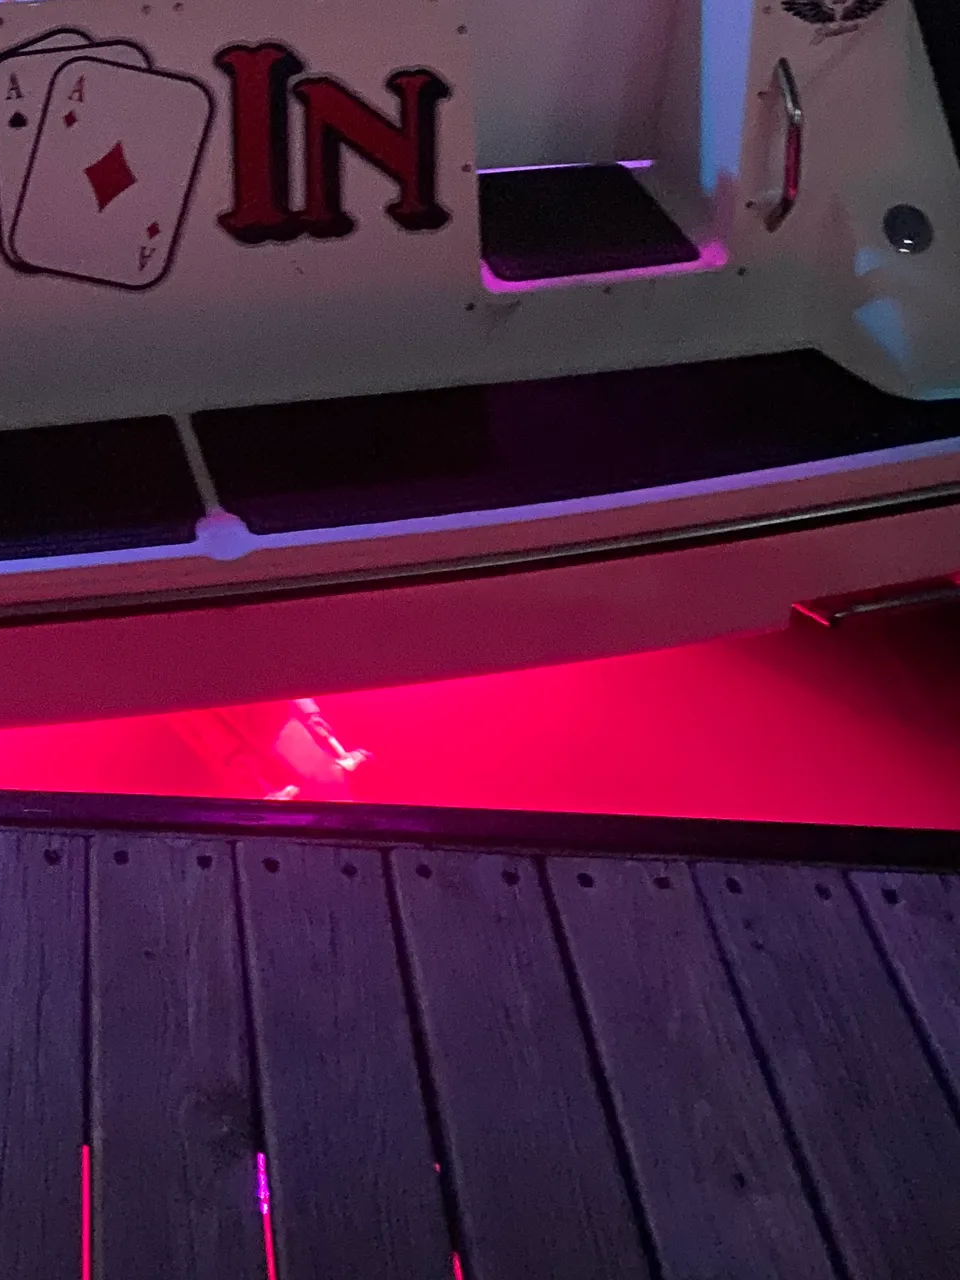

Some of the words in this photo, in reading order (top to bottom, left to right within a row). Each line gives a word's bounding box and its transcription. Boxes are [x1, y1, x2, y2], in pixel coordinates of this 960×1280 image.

[4, 72, 25, 101] A
[66, 73, 86, 104] A
[214, 42, 451, 243] IN
[138, 244, 157, 272] A
